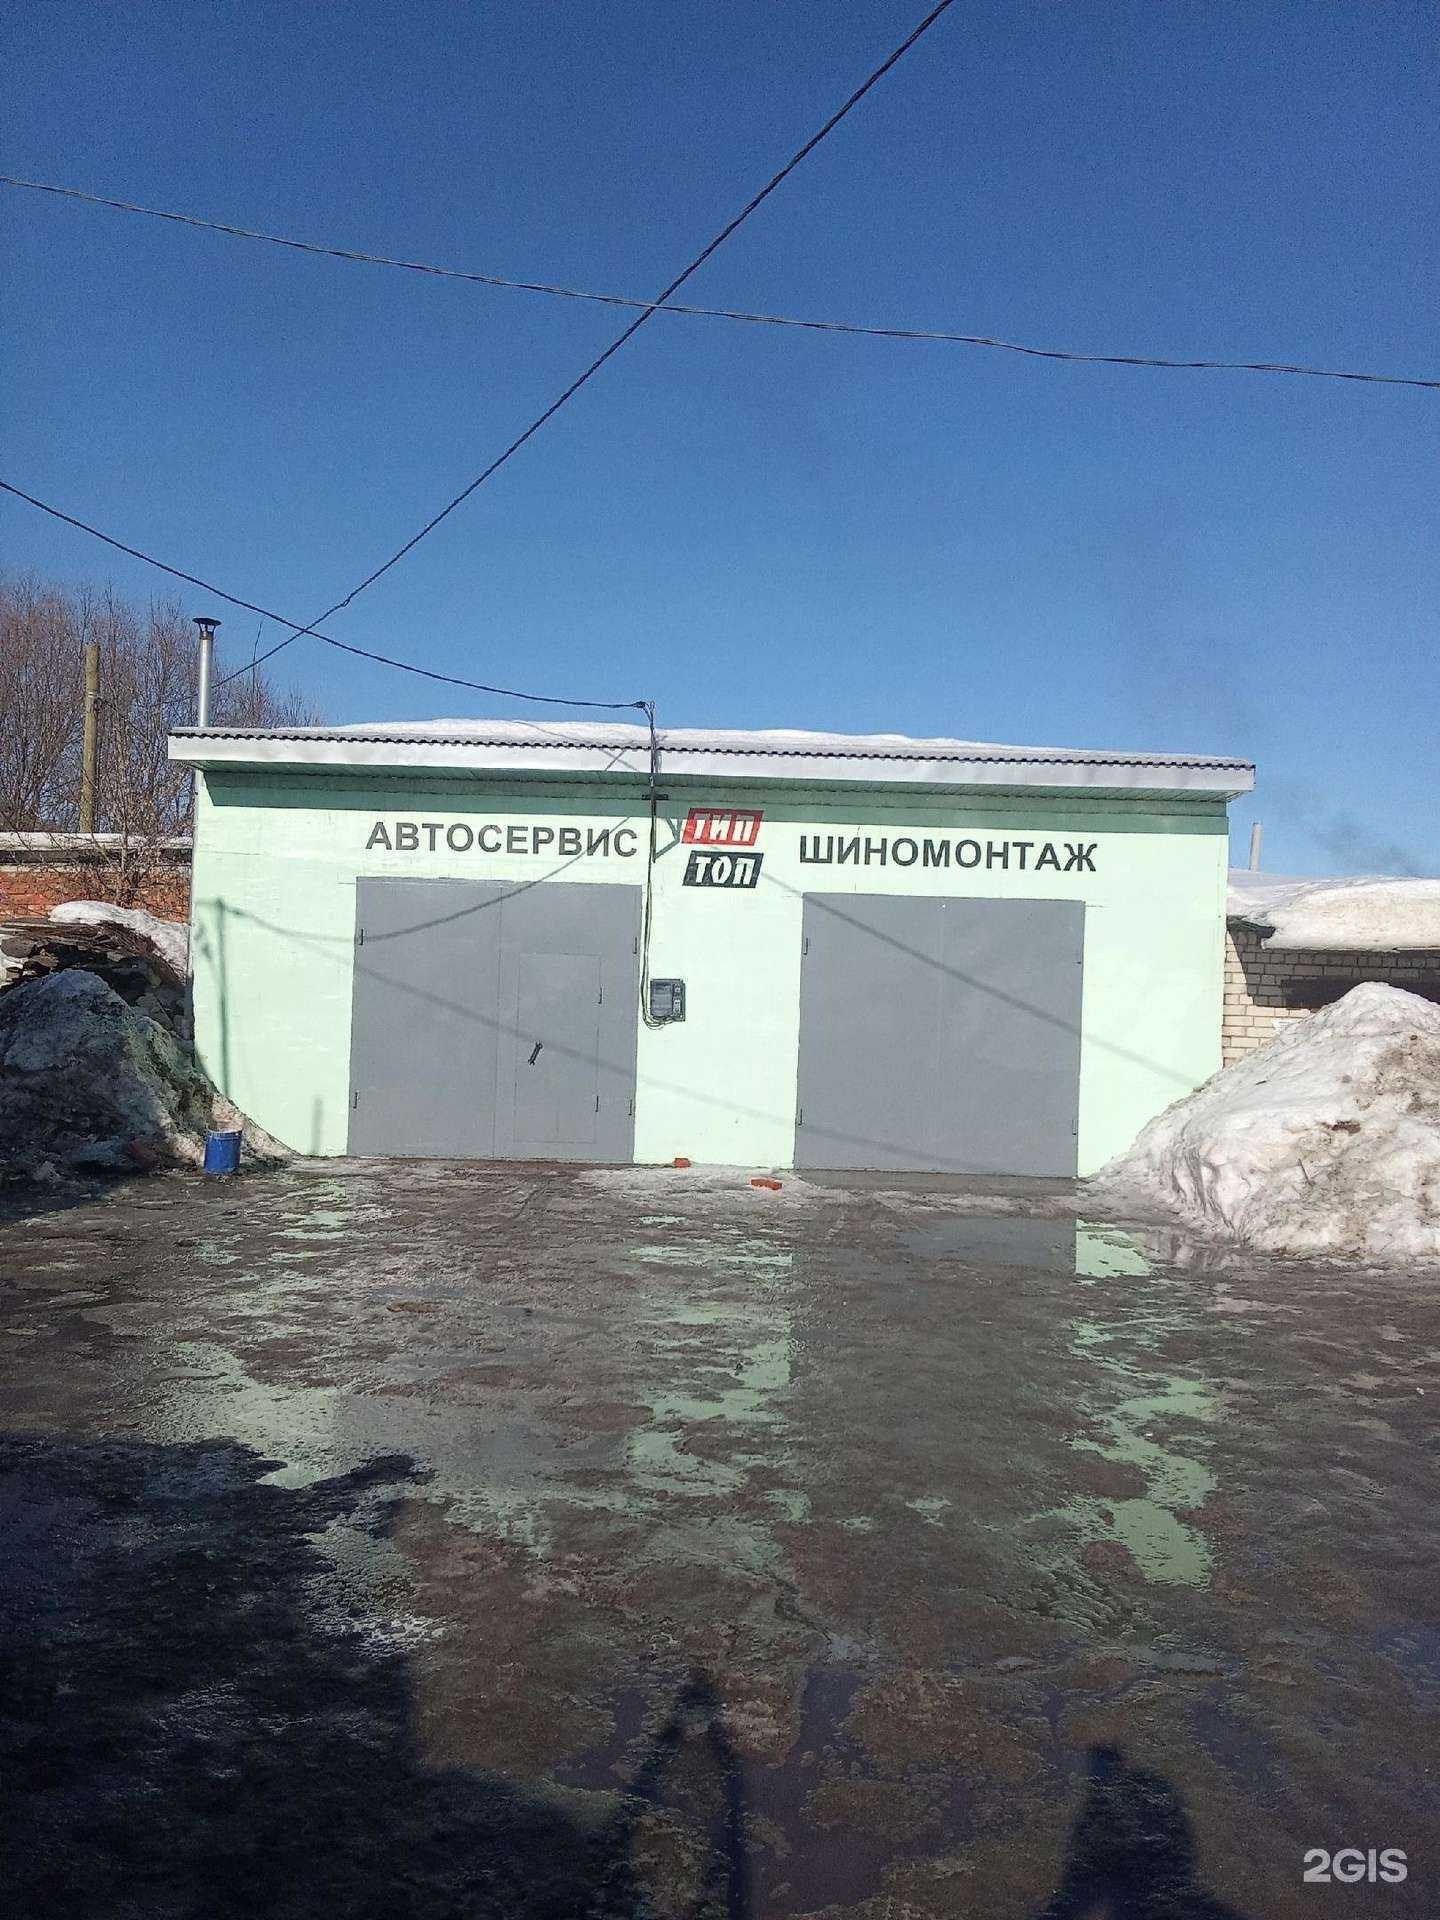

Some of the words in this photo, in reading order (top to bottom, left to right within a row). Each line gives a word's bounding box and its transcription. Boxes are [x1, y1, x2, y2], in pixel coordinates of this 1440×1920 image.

[366, 821, 638, 856] АВТОСЕРВИС
[693, 813, 755, 842] ТИП
[800, 835, 1098, 871] ШИНОМОНТАЖ
[695, 855, 756, 885] ТОП
